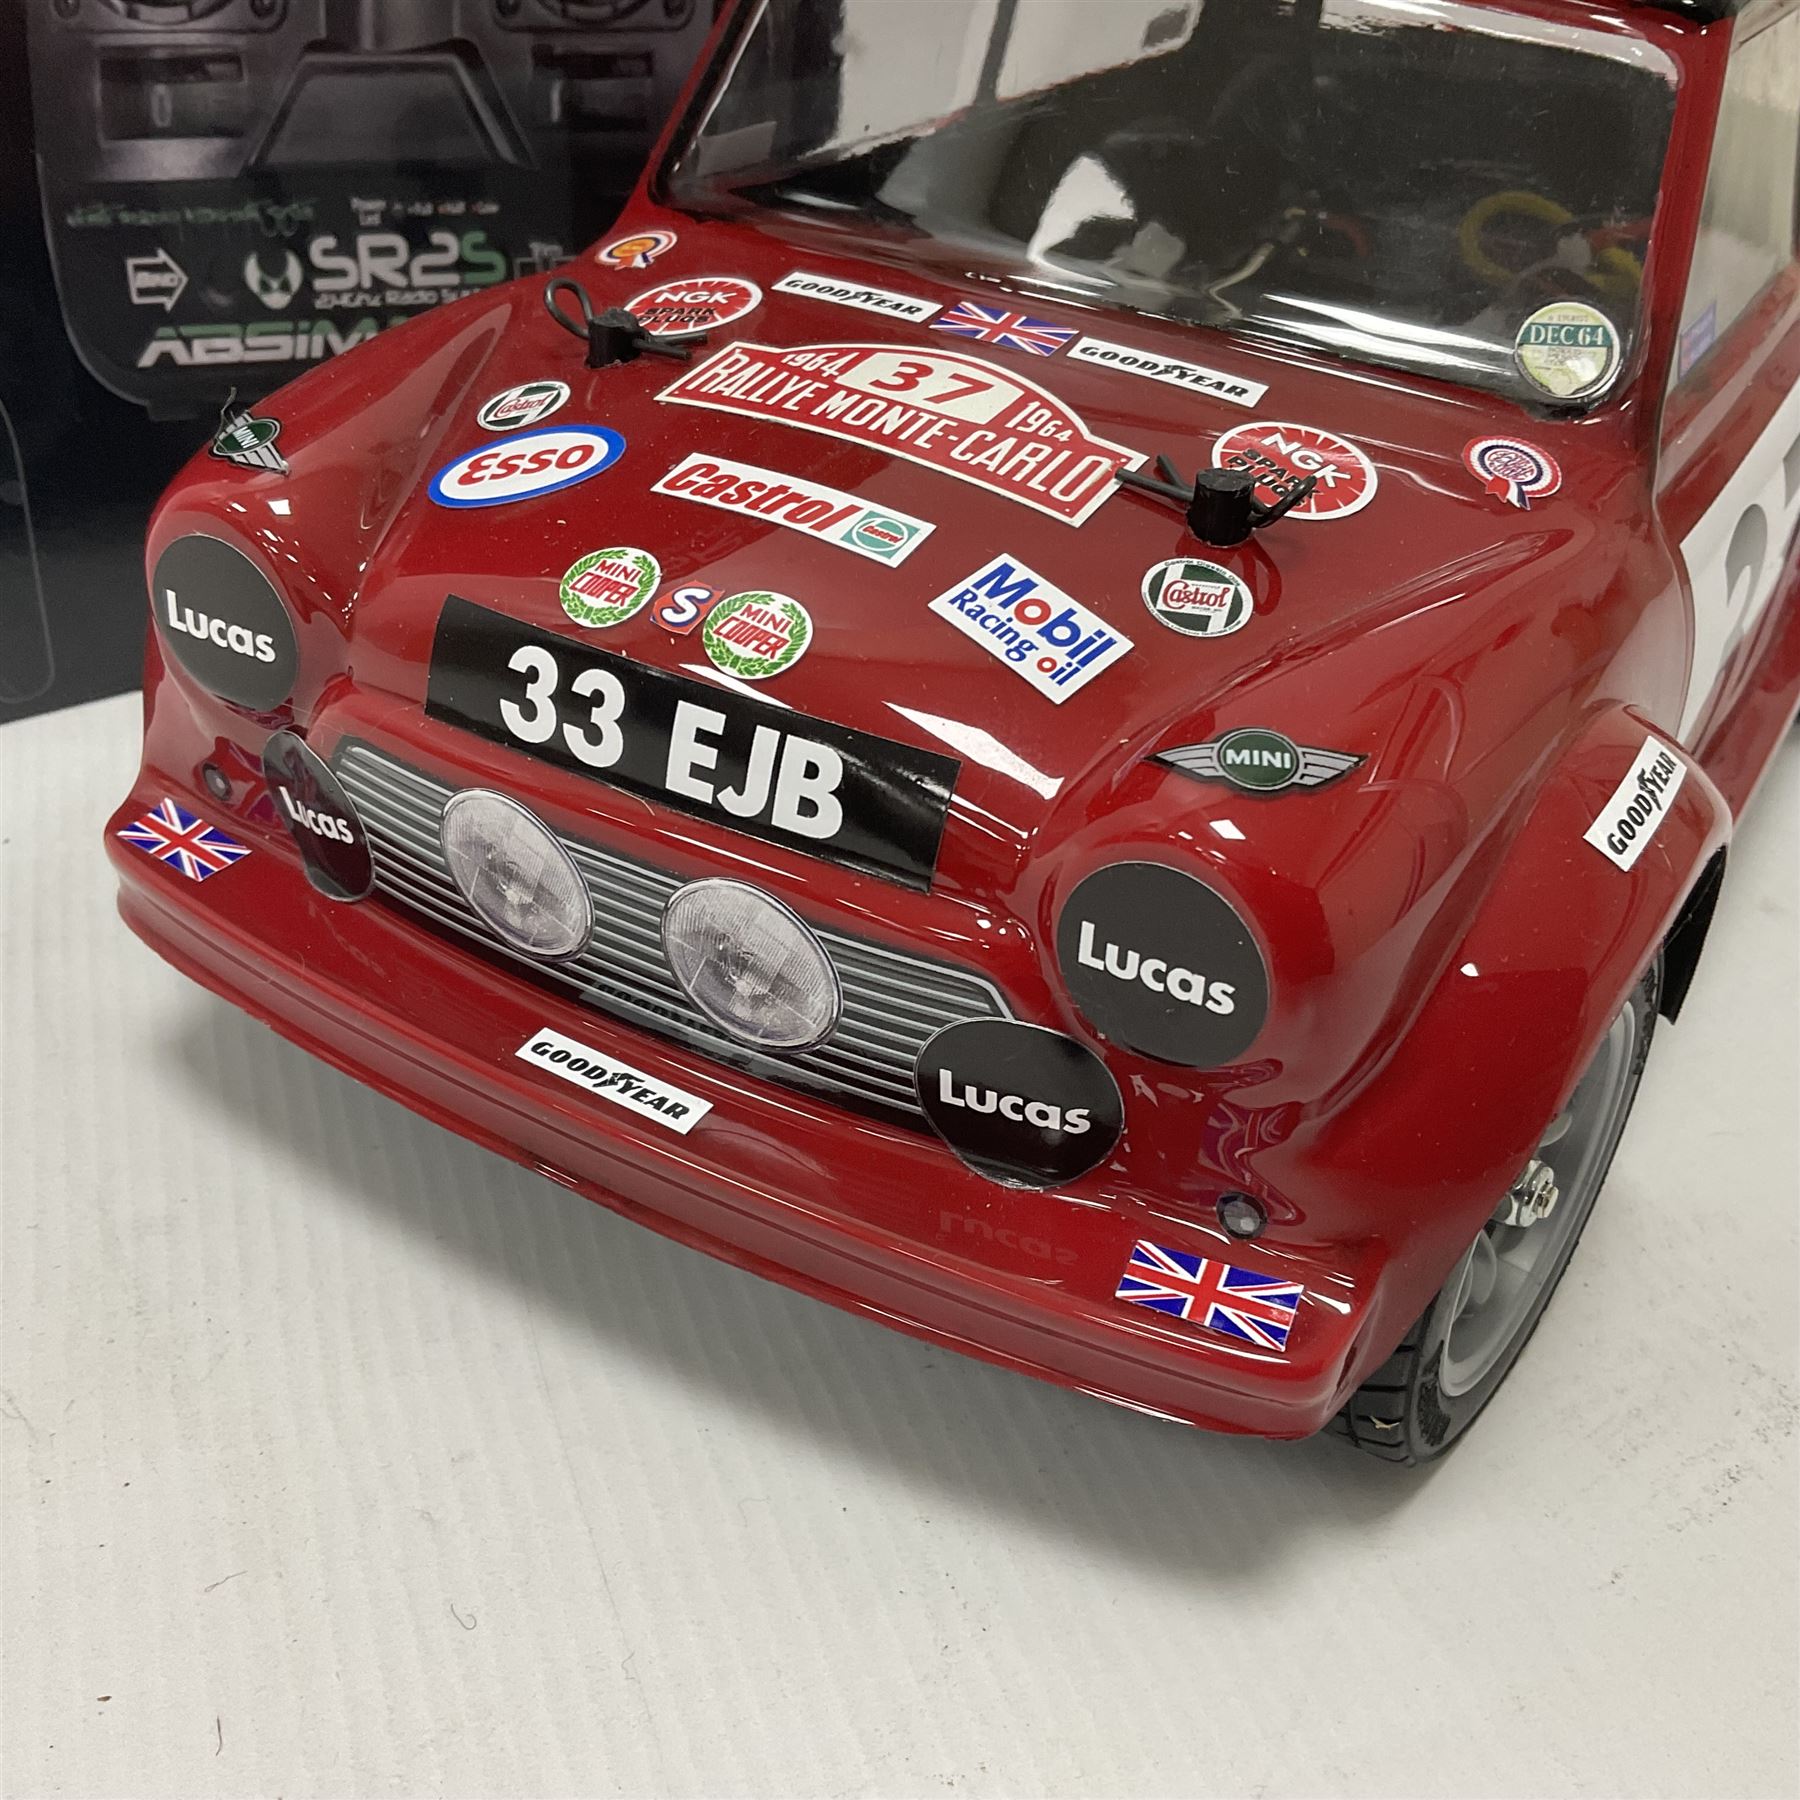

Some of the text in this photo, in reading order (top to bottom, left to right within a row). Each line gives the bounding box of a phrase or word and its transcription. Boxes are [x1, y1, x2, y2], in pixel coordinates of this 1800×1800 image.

[309, 230, 507, 291] SR2S
[645, 307, 716, 316] SPARK
[654, 291, 738, 304] NGK
[783, 279, 923, 319] GOODYEAR
[1530, 325, 1604, 345] DEC 64
[782, 353, 852, 377] 1964
[871, 362, 993, 406] 37
[1078, 345, 1249, 399] GOODYEAR
[690, 355, 1111, 502] RALLYE MONTE-CARLO
[1004, 401, 1075, 443] 1964
[1242, 448, 1320, 498] SPAR
[1260, 432, 1351, 488] NGK
[660, 461, 864, 532] Castrol
[862, 523, 903, 543] Castrol
[568, 572, 640, 606] COOPER
[596, 559, 642, 583] MINI
[1163, 580, 1230, 609] Castrol
[164, 589, 276, 663] Lucas
[661, 587, 710, 625] S
[740, 603, 792, 631] MINI
[971, 562, 1117, 669] Mobil
[713, 617, 789, 657] COOPER
[949, 587, 1082, 686] Racing oil
[499, 645, 843, 840] 33 EJB
[1225, 749, 1292, 769] MINI
[278, 786, 354, 845] Lucas
[1606, 751, 1678, 856] GOODYEAR
[1077, 921, 1237, 1016] Lucas
[530, 1041, 690, 1120] GOODYEAR
[939, 1068, 1092, 1135] Lucas
